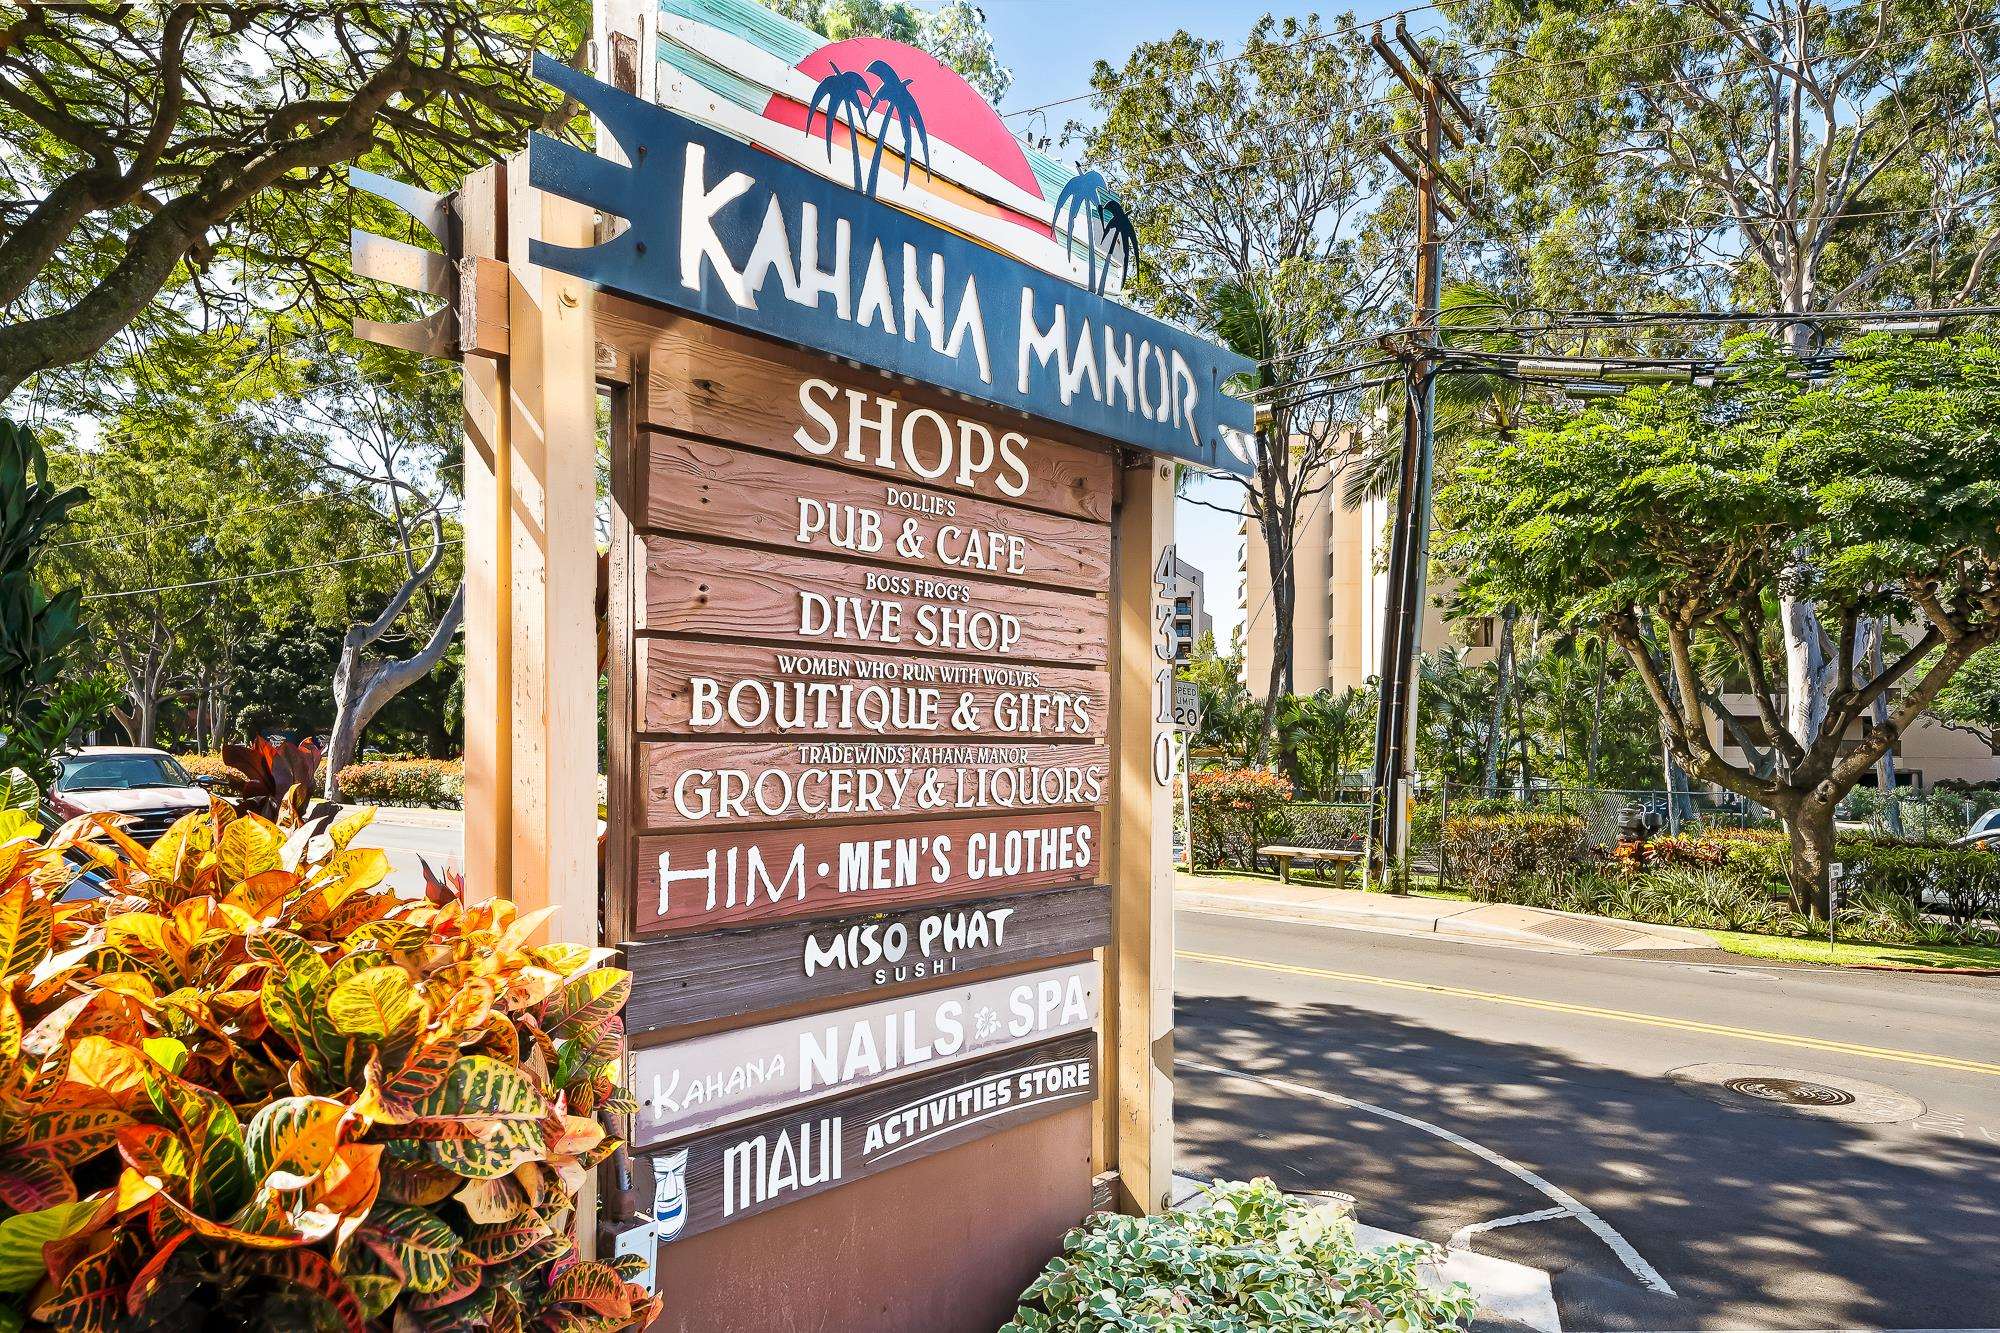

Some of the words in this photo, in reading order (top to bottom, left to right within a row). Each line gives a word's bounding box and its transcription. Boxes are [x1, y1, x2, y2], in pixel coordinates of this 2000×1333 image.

[680, 142, 993, 385] KAHANA
[1017, 285, 1203, 447] MANOR
[792, 378, 1030, 497] SHOPS
[886, 488, 957, 517] DOLLIE'S
[796, 497, 884, 553] PUB
[895, 518, 925, 559] &
[936, 525, 1026, 575] CAFE
[866, 573, 910, 596] BOSS
[914, 579, 970, 603] FROG'S
[798, 590, 902, 643] DIVE
[914, 605, 1022, 653] SHOP
[777, 655, 850, 676] WOMEN
[856, 659, 898, 679] WHO
[902, 663, 935, 682] RUN
[939, 666, 980, 684] WITH
[983, 668, 1040, 687] WOLVES
[688, 676, 940, 733] BOUTIQUE
[951, 691, 981, 733] &
[993, 692, 1091, 734] GIFTS
[1175, 707, 1197, 726] 20
[797, 746, 905, 765] TRADEWINDS
[909, 747, 973, 764] KAHANA
[976, 748, 1028, 764] MANOR
[673, 767, 912, 820] GROCERY
[917, 766, 946, 808] &
[955, 765, 1101, 808] LIQUORS
[838, 835, 951, 893] MEN'S
[966, 824, 1092, 880] CLOTHES
[804, 922, 908, 977] MISO
[919, 908, 1014, 956] PHAT
[874, 957, 957, 985] SUSHI
[652, 1052, 786, 1119] KAHANA
[799, 1001, 964, 1092] NAILS
[1007, 976, 1088, 1038] SPA
[723, 1116, 843, 1218] MAUI
[862, 1082, 1012, 1157] ACTIVITIES
[1018, 1062, 1091, 1100] STORE
